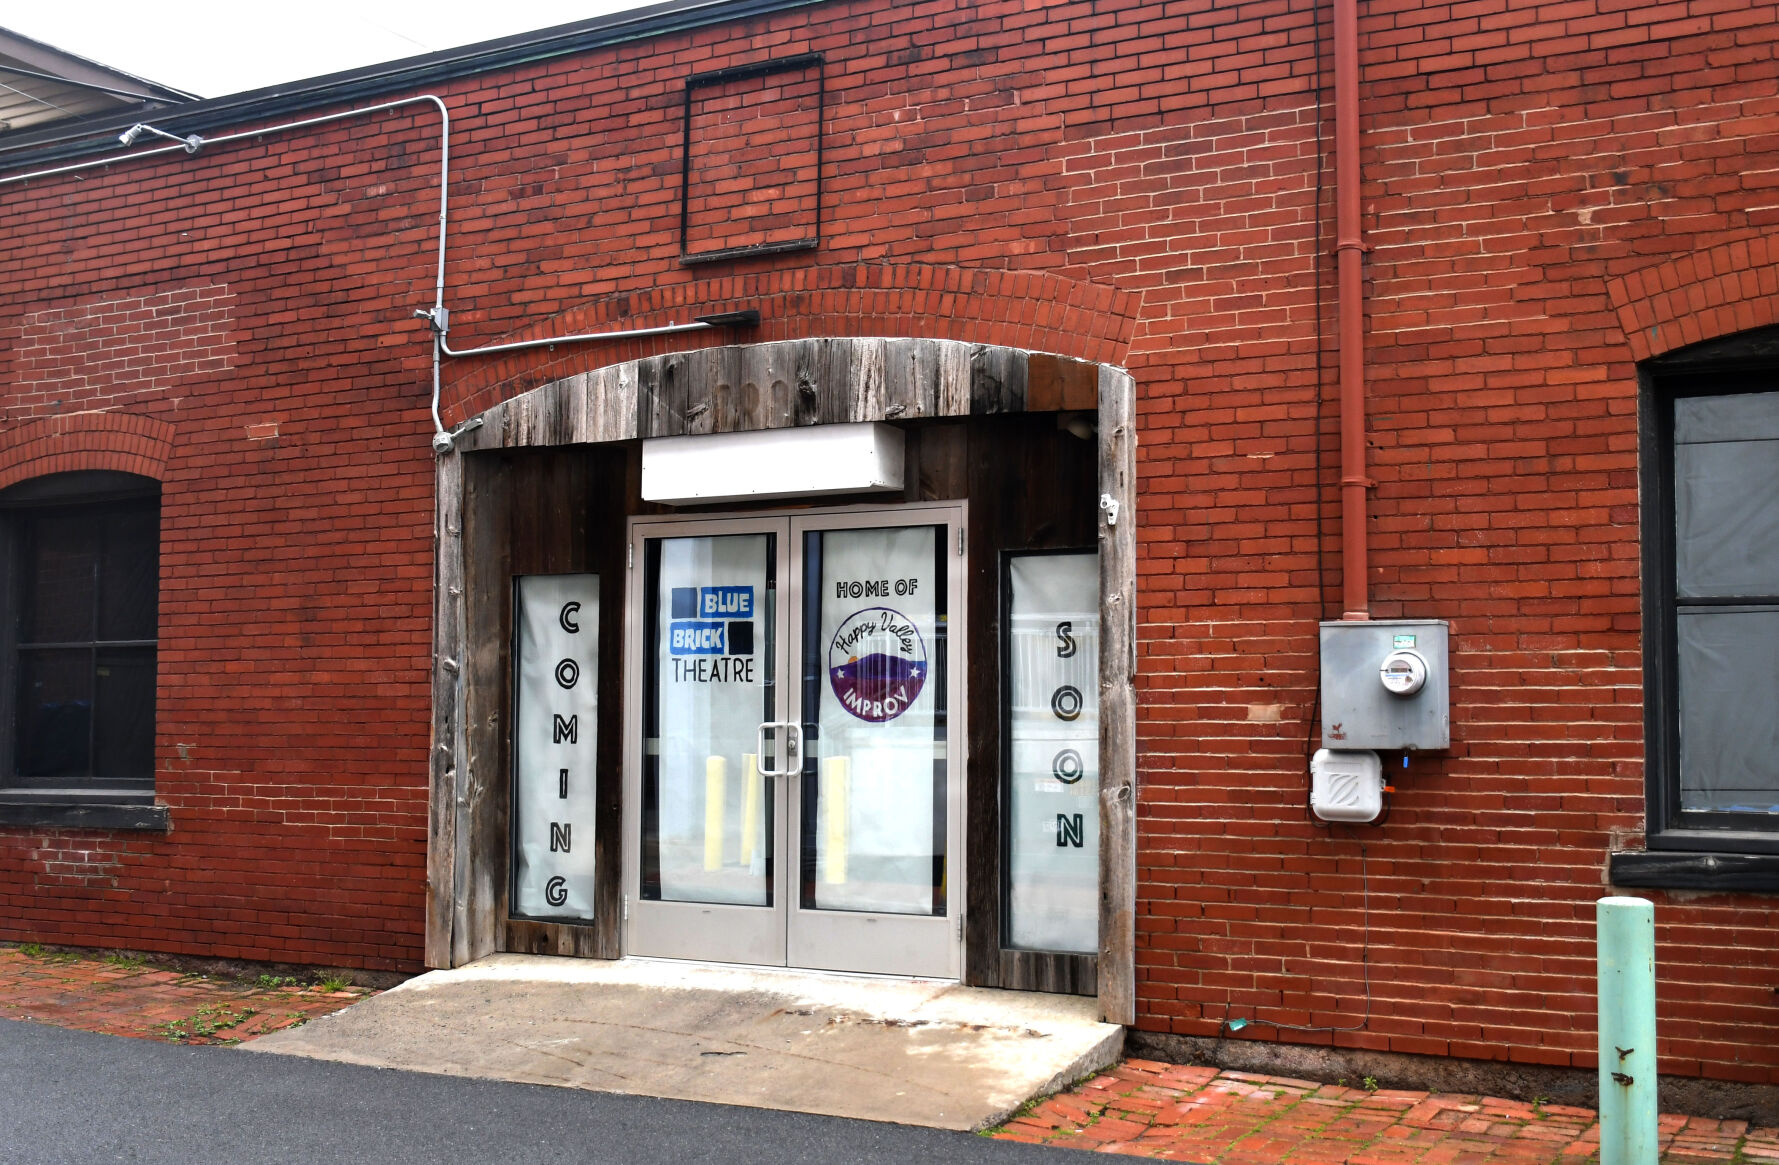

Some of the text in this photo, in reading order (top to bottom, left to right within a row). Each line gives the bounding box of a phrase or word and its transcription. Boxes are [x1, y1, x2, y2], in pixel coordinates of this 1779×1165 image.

[704, 590, 751, 614] BLUE
[836, 578, 919, 599] HOME OF
[672, 627, 724, 651] BRICK
[835, 611, 916, 655] Happy Valley
[671, 657, 754, 683] THEATRE
[843, 685, 909, 718] IMPROV
[1051, 621, 1084, 848] SOON
[545, 601, 581, 907] COMING
